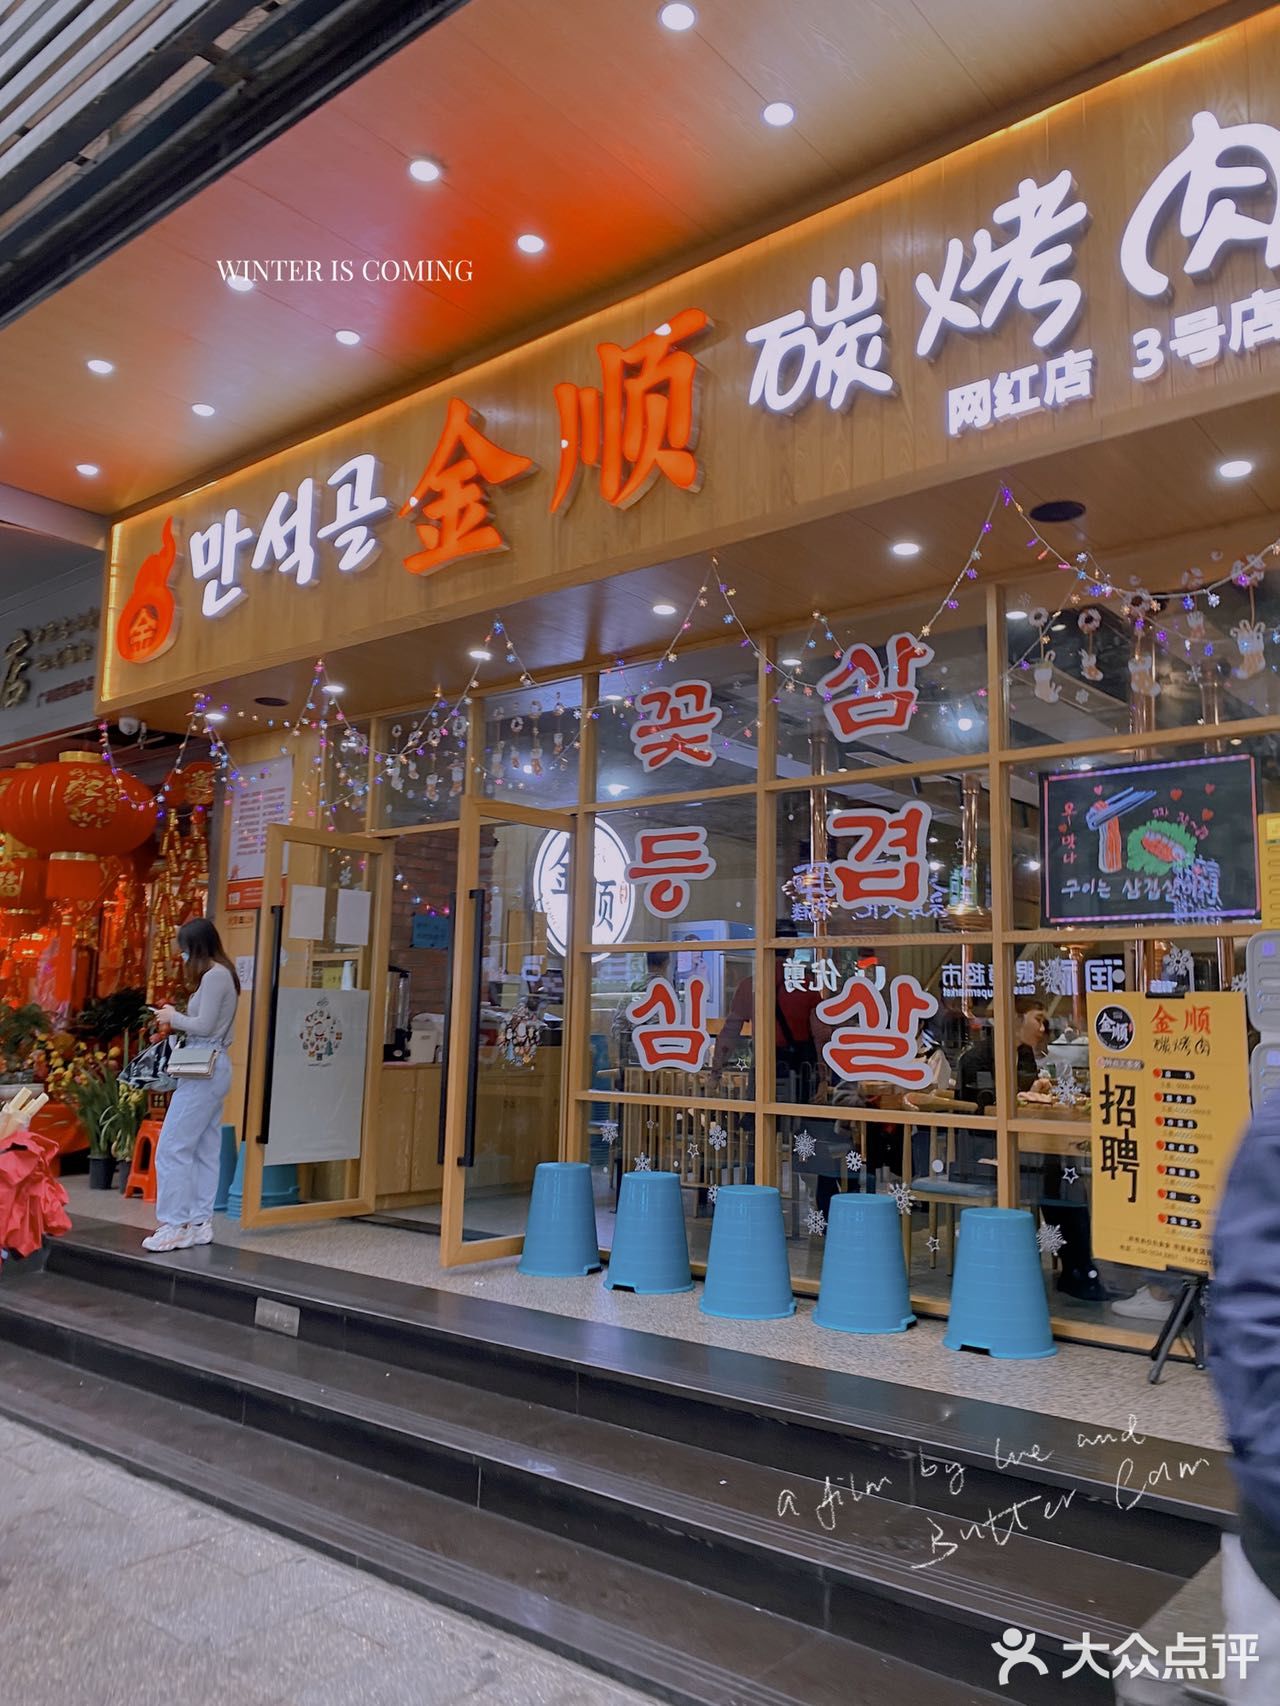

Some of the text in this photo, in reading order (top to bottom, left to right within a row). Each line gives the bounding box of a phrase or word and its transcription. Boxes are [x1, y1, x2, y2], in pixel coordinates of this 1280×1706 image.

[948, 289, 1280, 436] 网红店 3号店
[190, 454, 389, 617] 만석골
[1152, 1004, 1211, 1035] 金顺
[1099, 1074, 1140, 1203] 招聘
